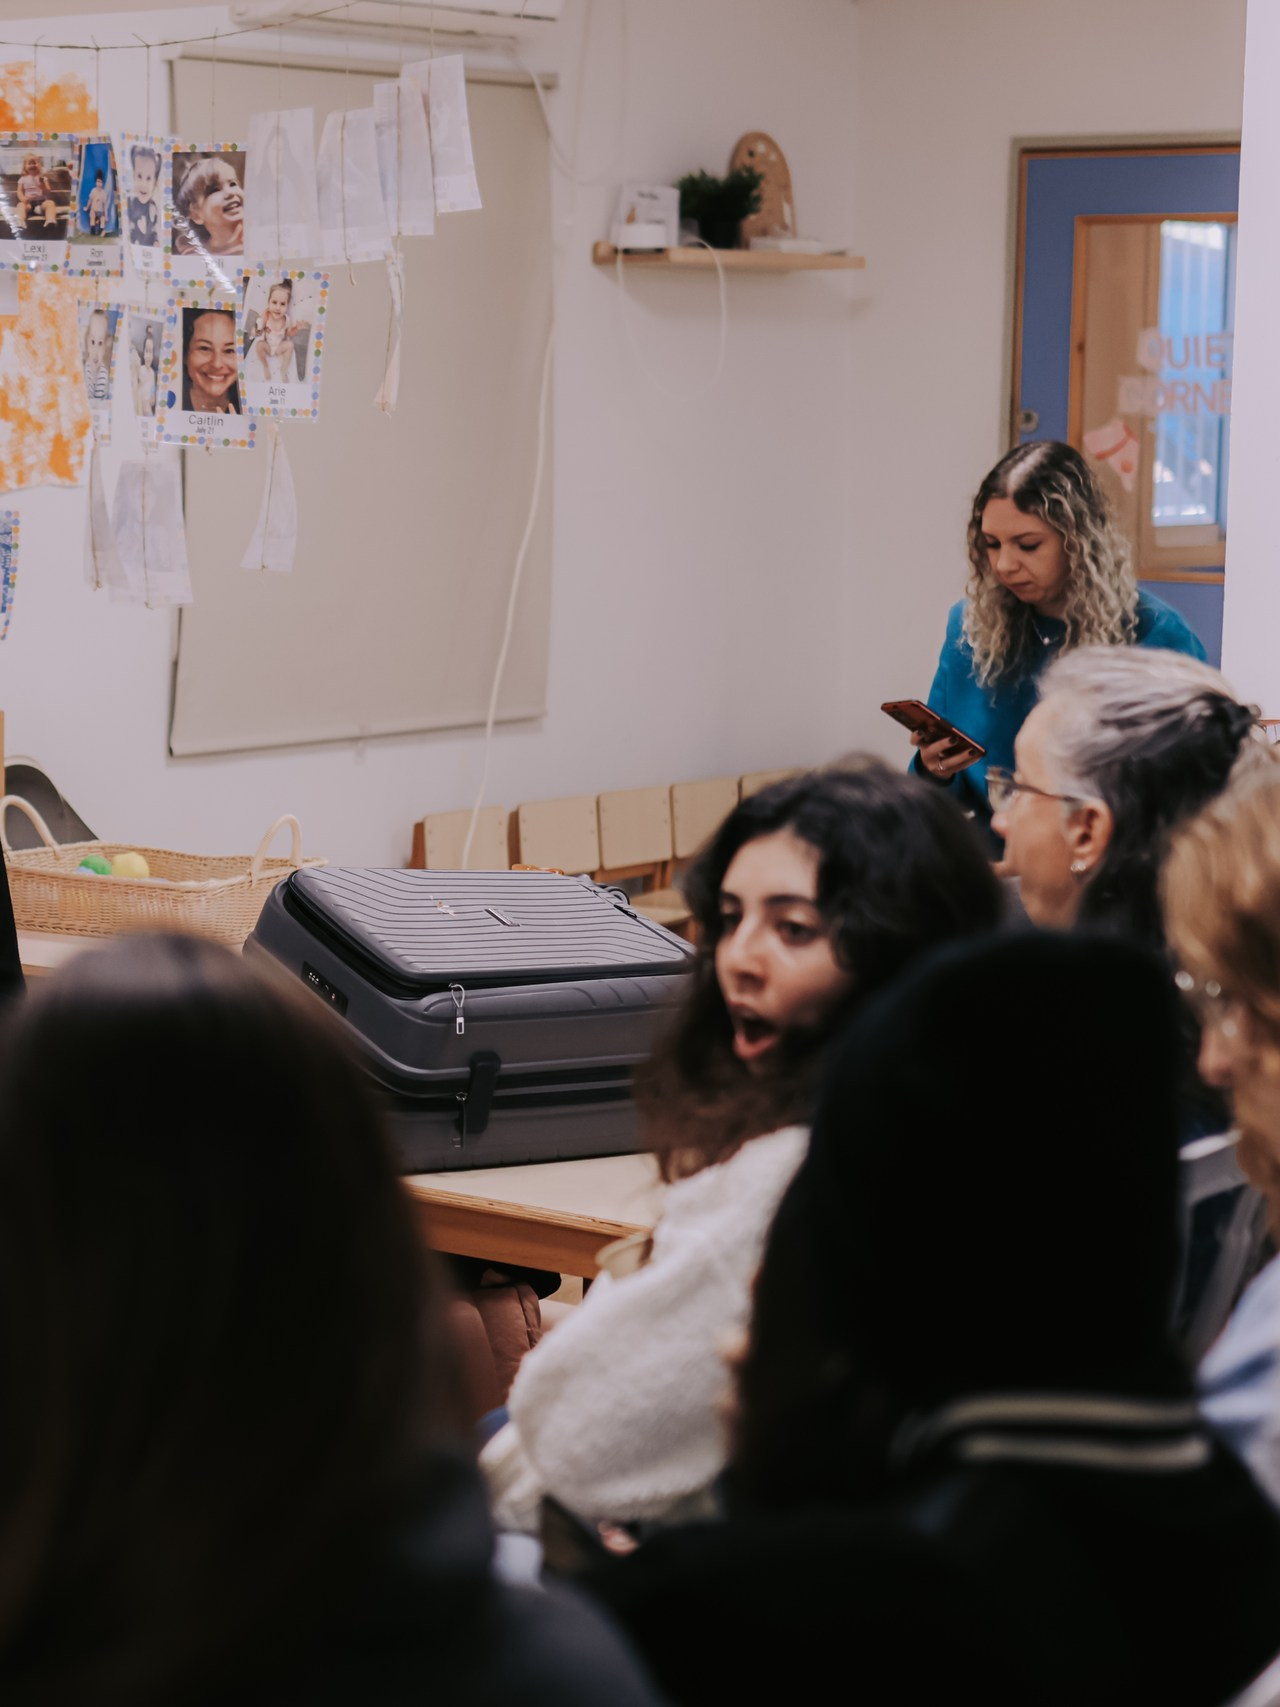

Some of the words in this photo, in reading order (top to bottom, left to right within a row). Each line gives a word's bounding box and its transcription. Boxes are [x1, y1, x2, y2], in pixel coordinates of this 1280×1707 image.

[24, 243, 46, 253] Lexi
[268, 386, 286, 396] Arie
[188, 414, 224, 427] Caitlin
[196, 427, 206, 435] July
[207, 427, 215, 435] 21
